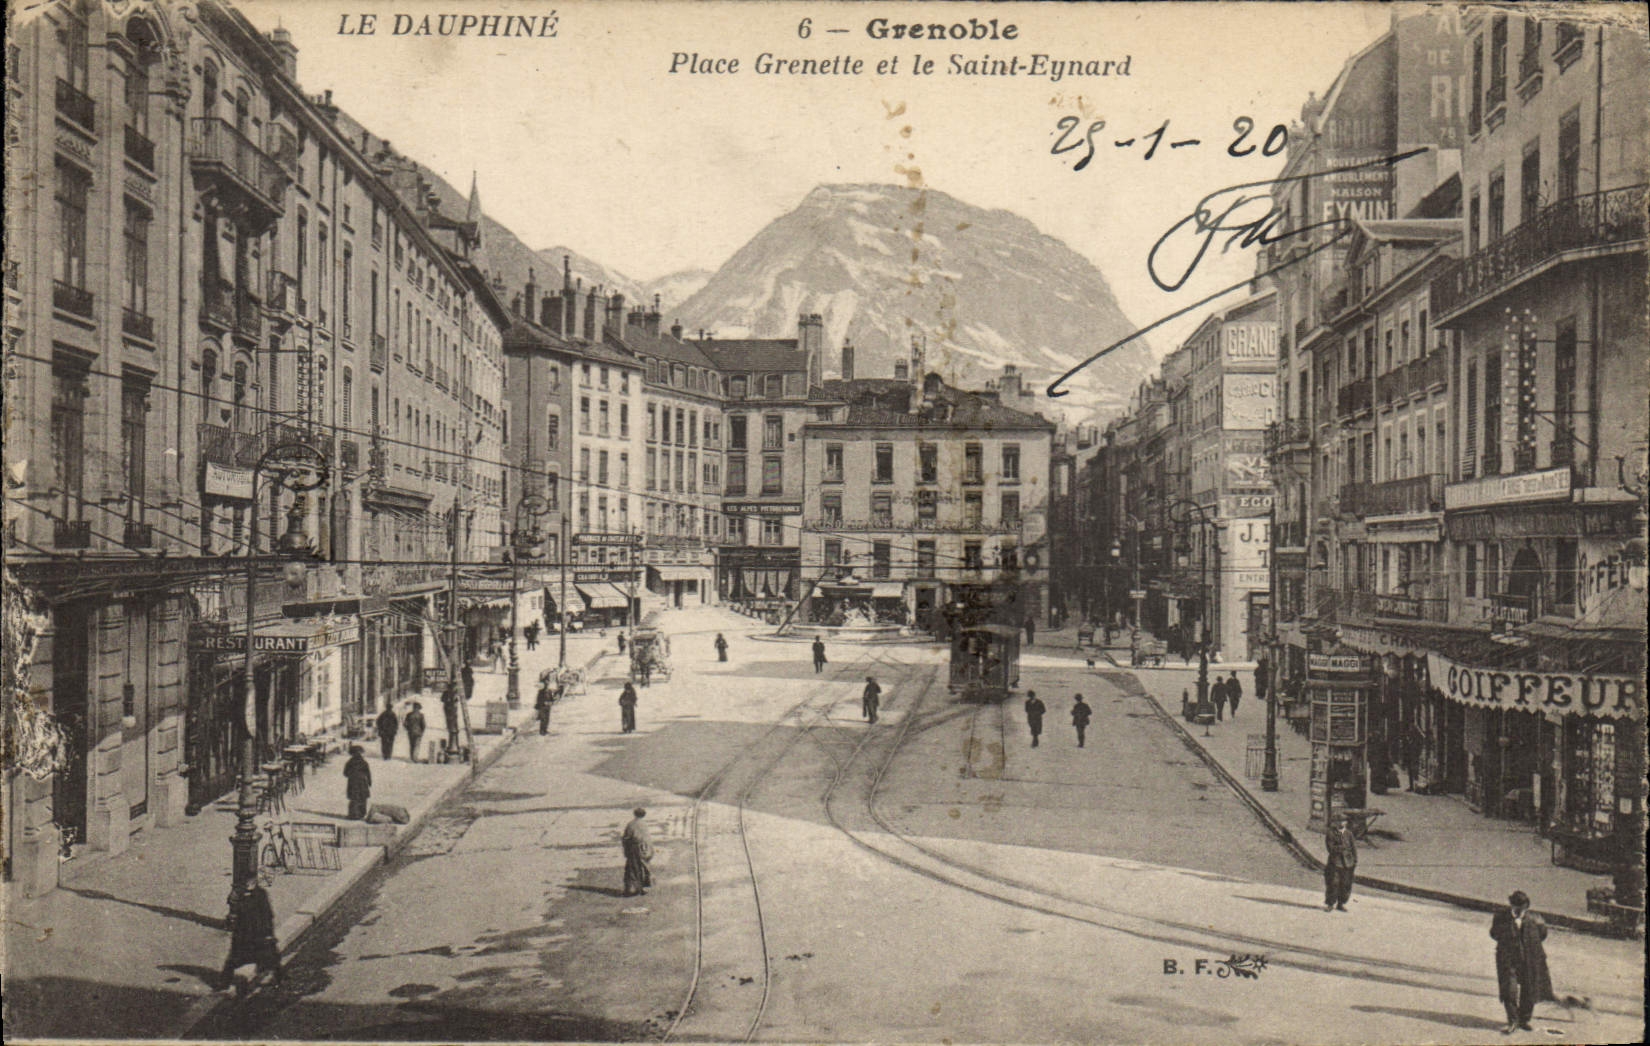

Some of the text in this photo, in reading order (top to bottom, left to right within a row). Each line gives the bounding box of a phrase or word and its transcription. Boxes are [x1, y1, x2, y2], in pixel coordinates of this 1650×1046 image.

[1331, 187, 1383, 198] MAISON
[205, 636, 308, 650] RESTURANT
[1331, 659, 1359, 668] MAGGI
[1448, 666, 1637, 711] COIFFEUR
